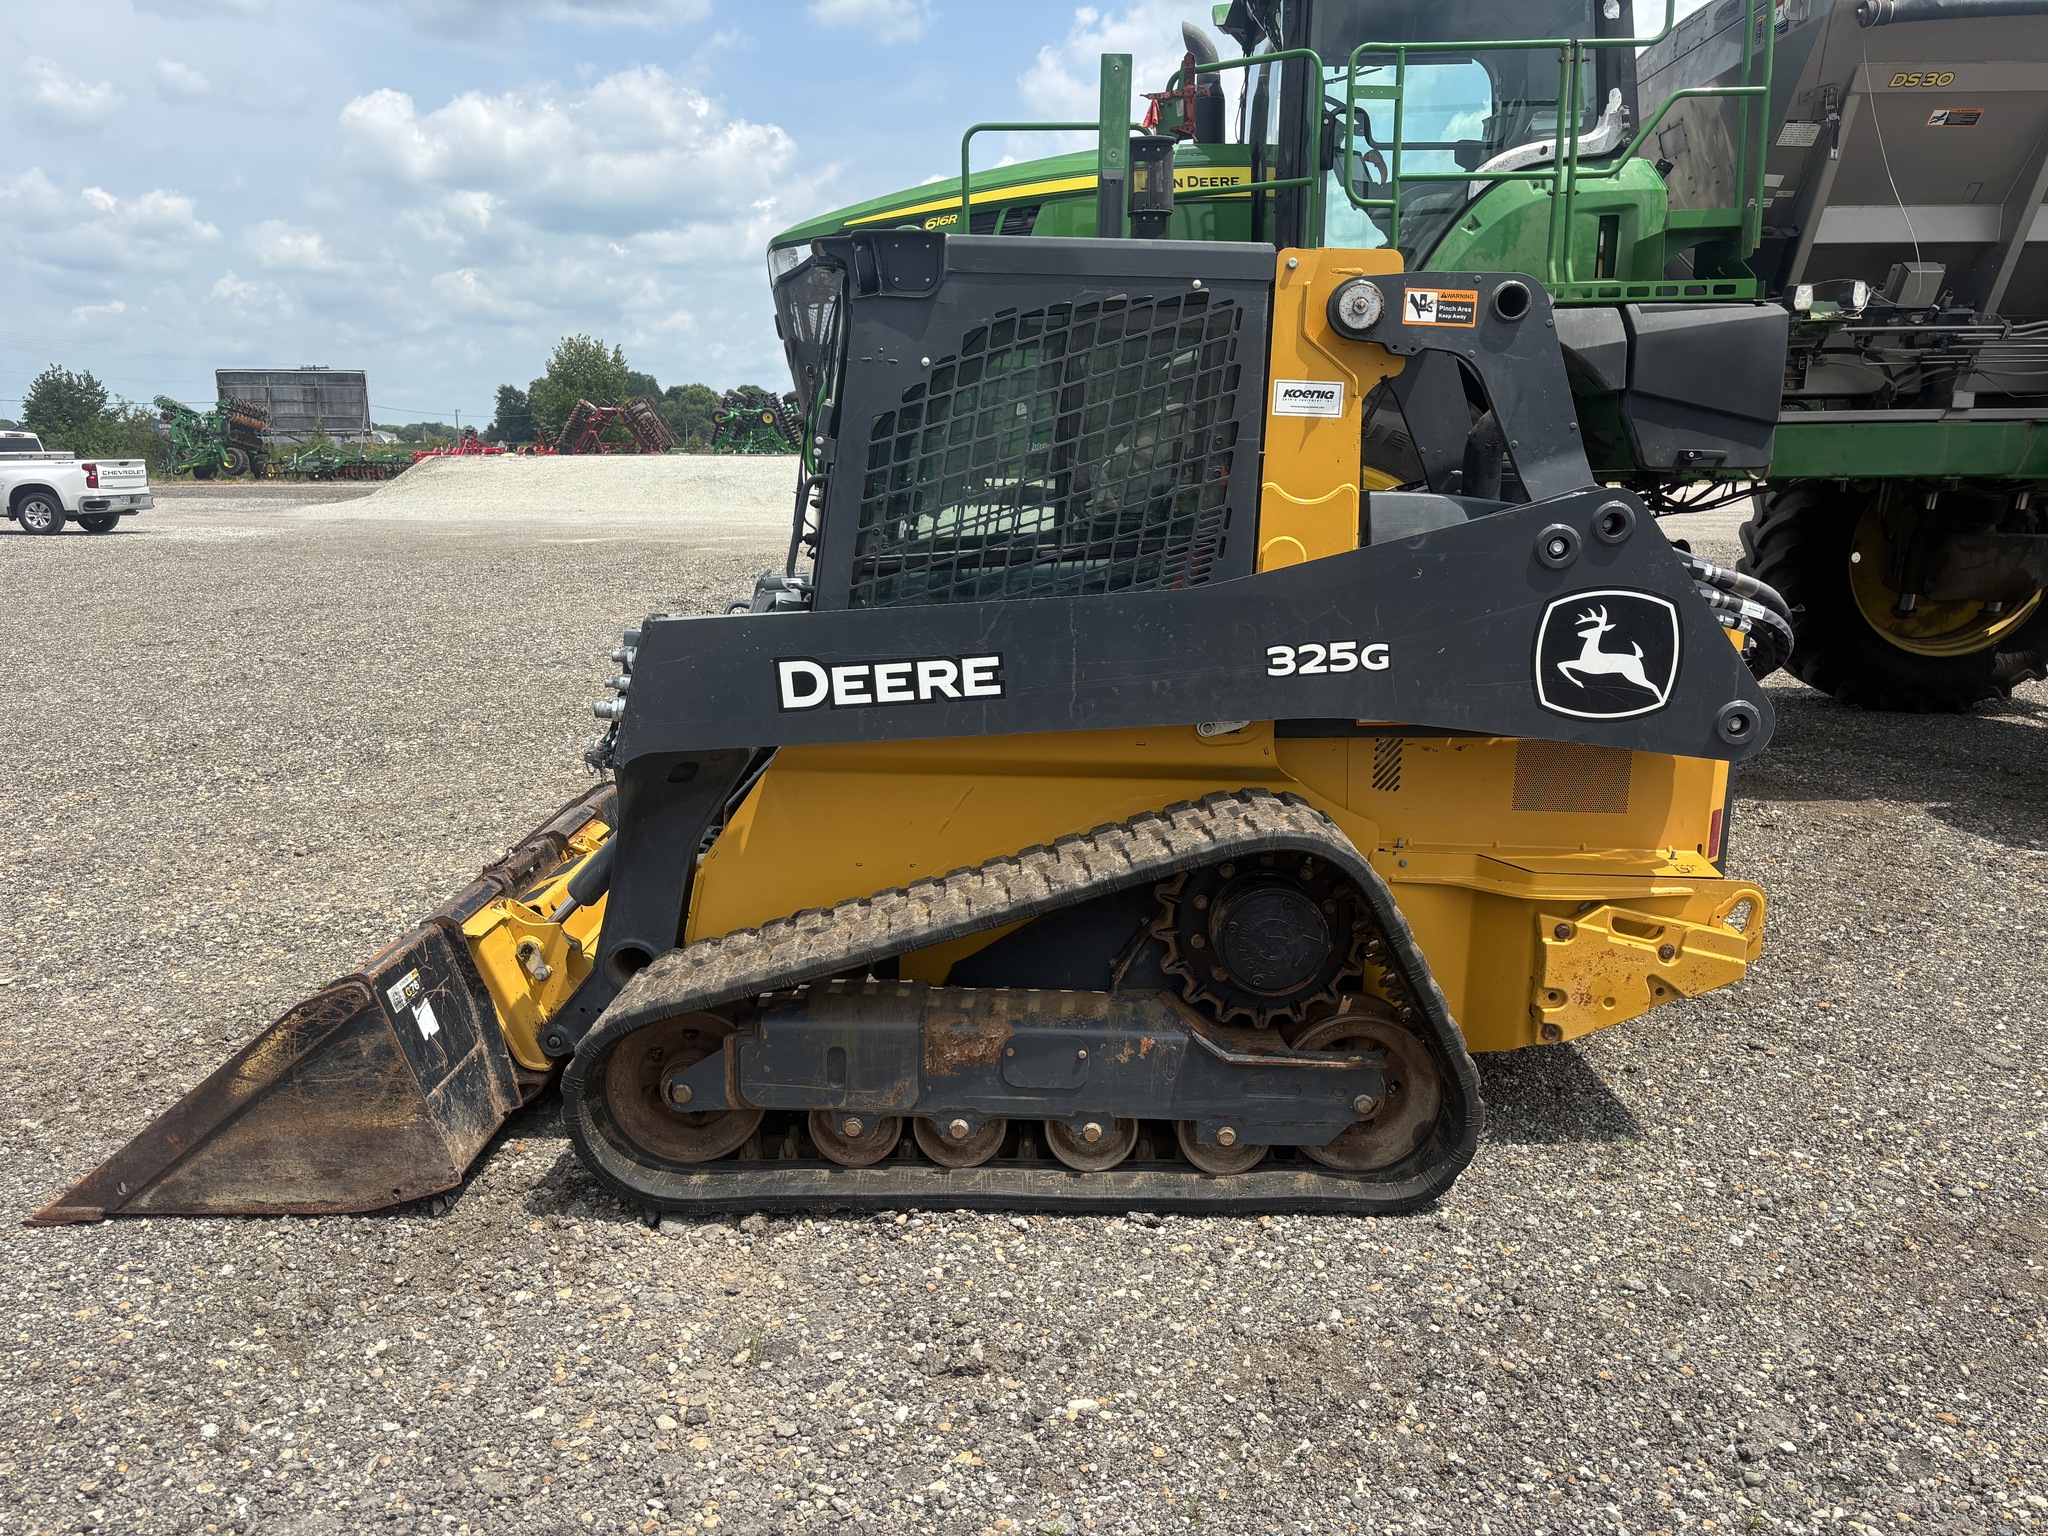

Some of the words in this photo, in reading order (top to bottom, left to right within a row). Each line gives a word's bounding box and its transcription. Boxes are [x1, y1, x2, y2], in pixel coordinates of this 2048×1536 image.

[1187, 175, 1240, 188] DEERE
[924, 214, 958, 230] 616R
[1447, 292, 1475, 300] WARNING
[1438, 311, 1452, 319] Keep
[1266, 641, 1390, 677] 325G
[778, 656, 1002, 709] DEERE
[405, 980, 420, 997] G76
